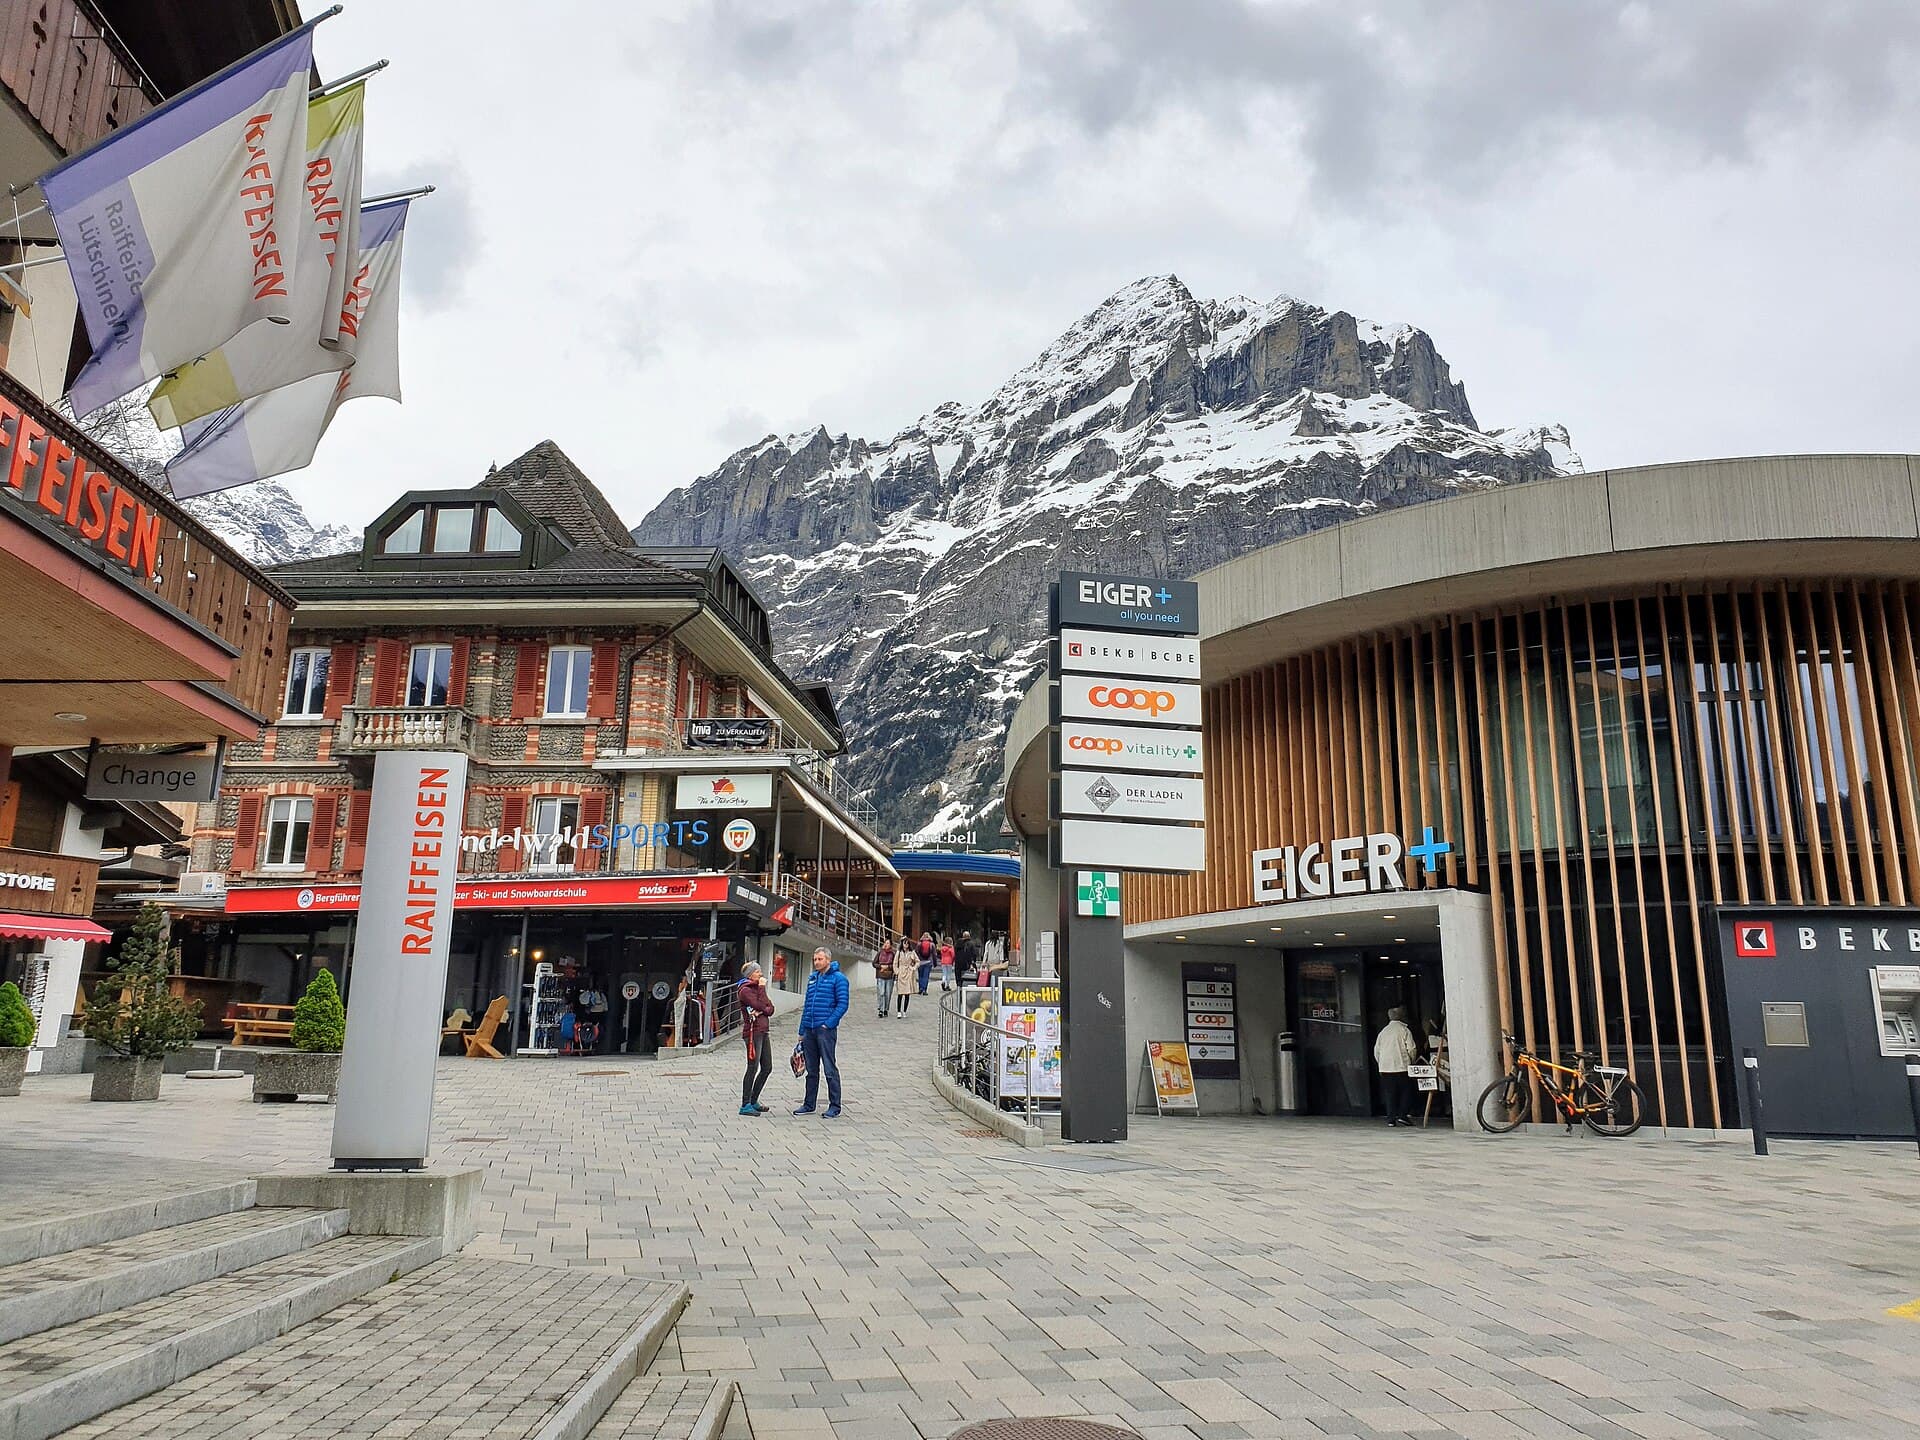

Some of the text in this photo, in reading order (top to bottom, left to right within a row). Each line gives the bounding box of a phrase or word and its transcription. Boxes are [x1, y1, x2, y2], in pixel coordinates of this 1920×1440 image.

[240, 113, 288, 300] RFFEISEN
[1120, 609, 1180, 623] all you need
[1090, 646, 1195, 663] BEKB BCBE
[1088, 685, 1176, 717] coop
[1068, 735, 1180, 758] coop vitality
[103, 764, 196, 791] Change
[1126, 788, 1183, 800] DER LADEN
[401, 768, 449, 954] RAIFFEISEN
[0, 872, 56, 892] STORE
[639, 882, 689, 896] swissrent
[315, 892, 360, 904] Bergführer
[472, 889, 489, 899] Ski-
[492, 889, 508, 899] und
[510, 888, 587, 899] Snowboardschule
[1798, 927, 1920, 952] BEKB
[1195, 1014, 1227, 1026] coop
